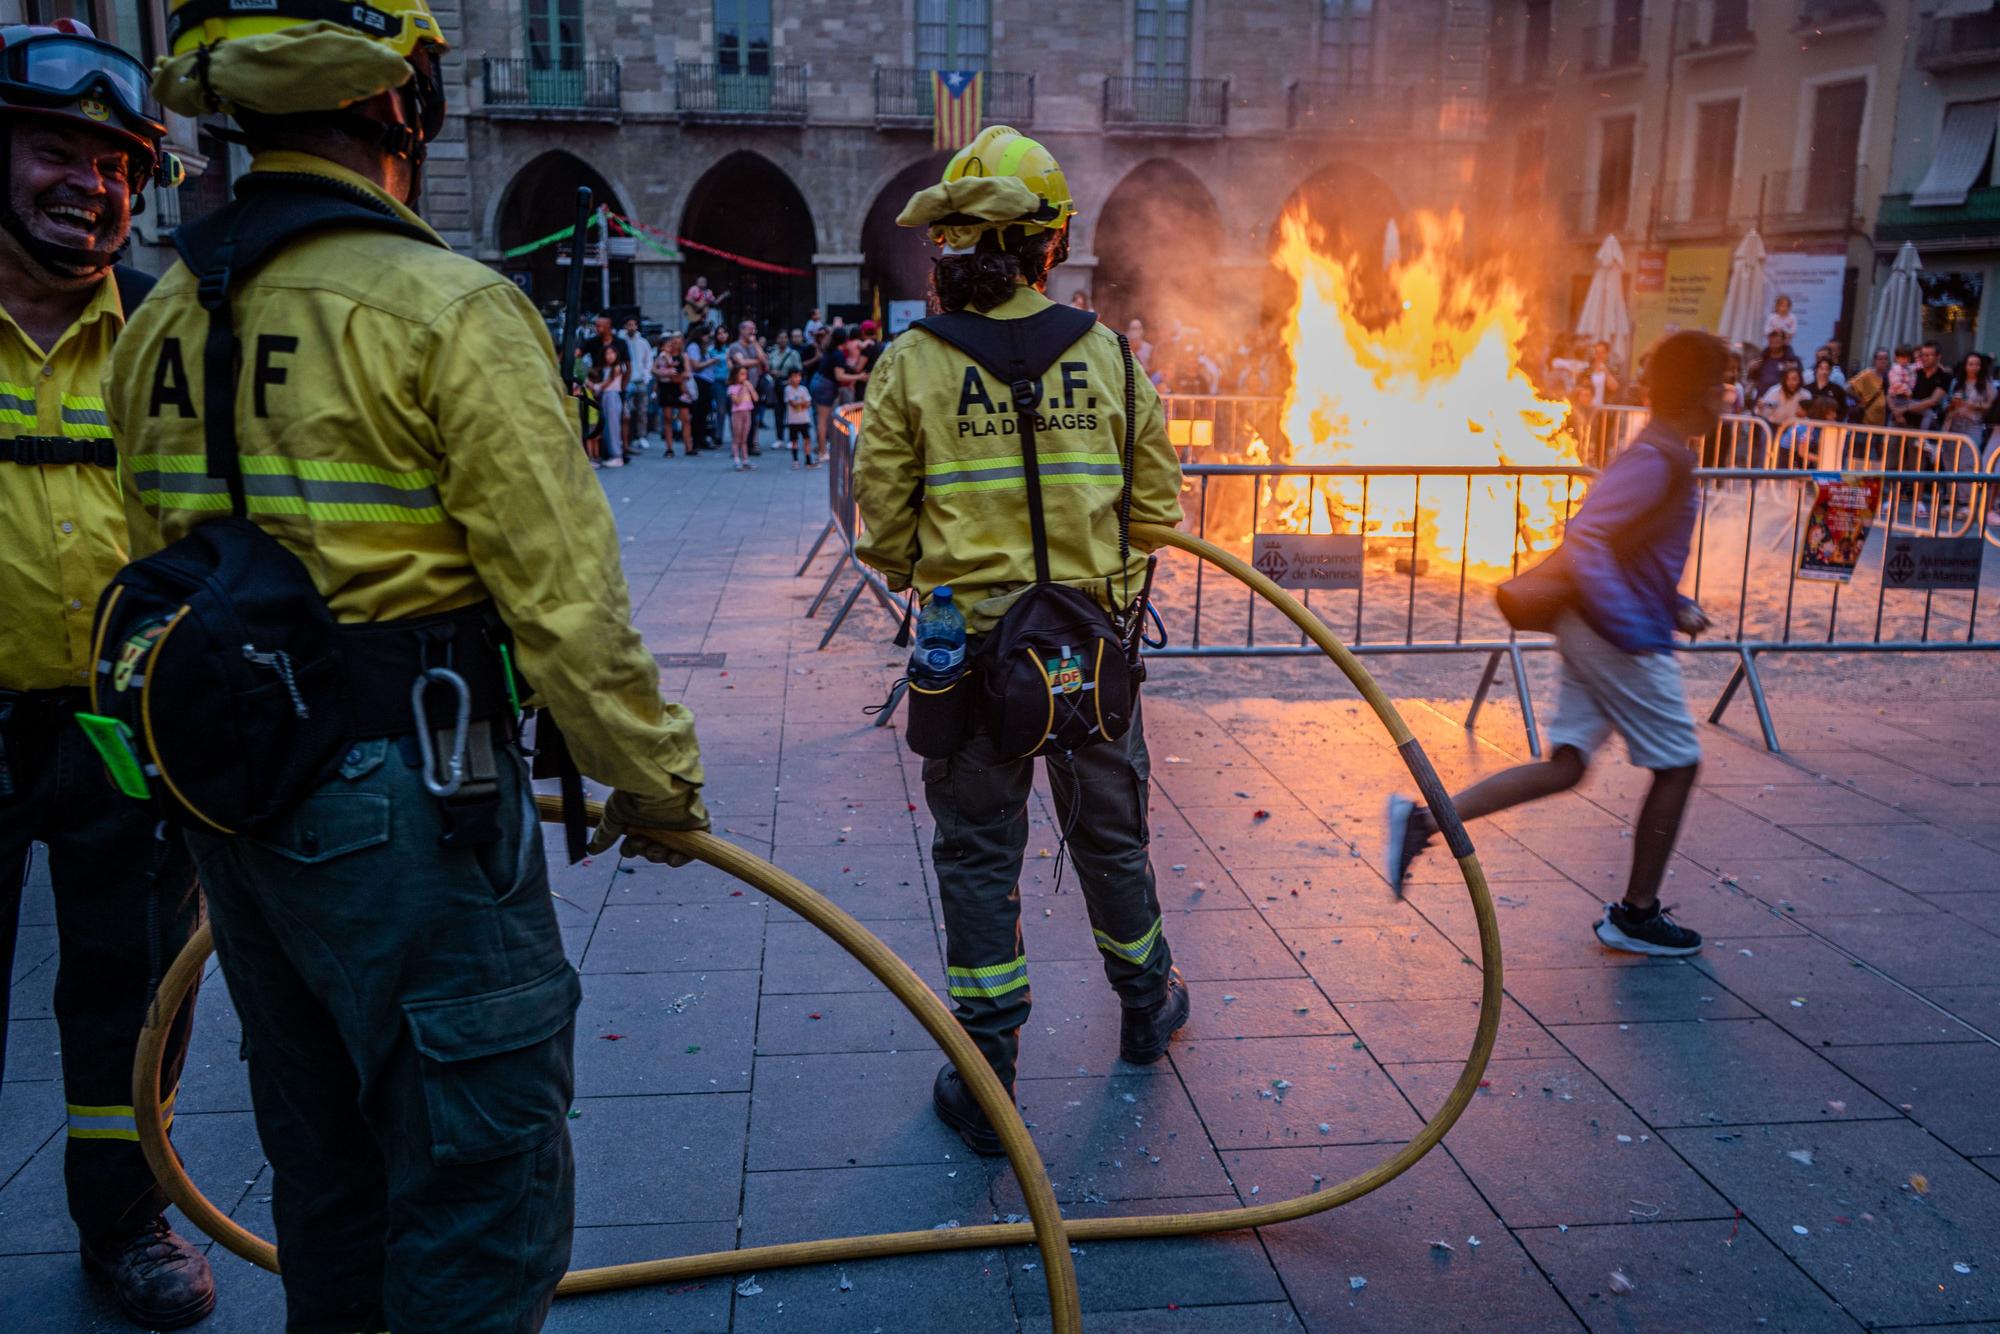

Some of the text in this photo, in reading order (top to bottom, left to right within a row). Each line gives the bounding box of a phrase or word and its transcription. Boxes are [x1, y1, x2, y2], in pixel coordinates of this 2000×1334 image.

[958, 414, 1097, 438] PLA D BAGES
[1292, 552, 1361, 565] Ajuntament
[1292, 568, 1360, 580] de Manresa
